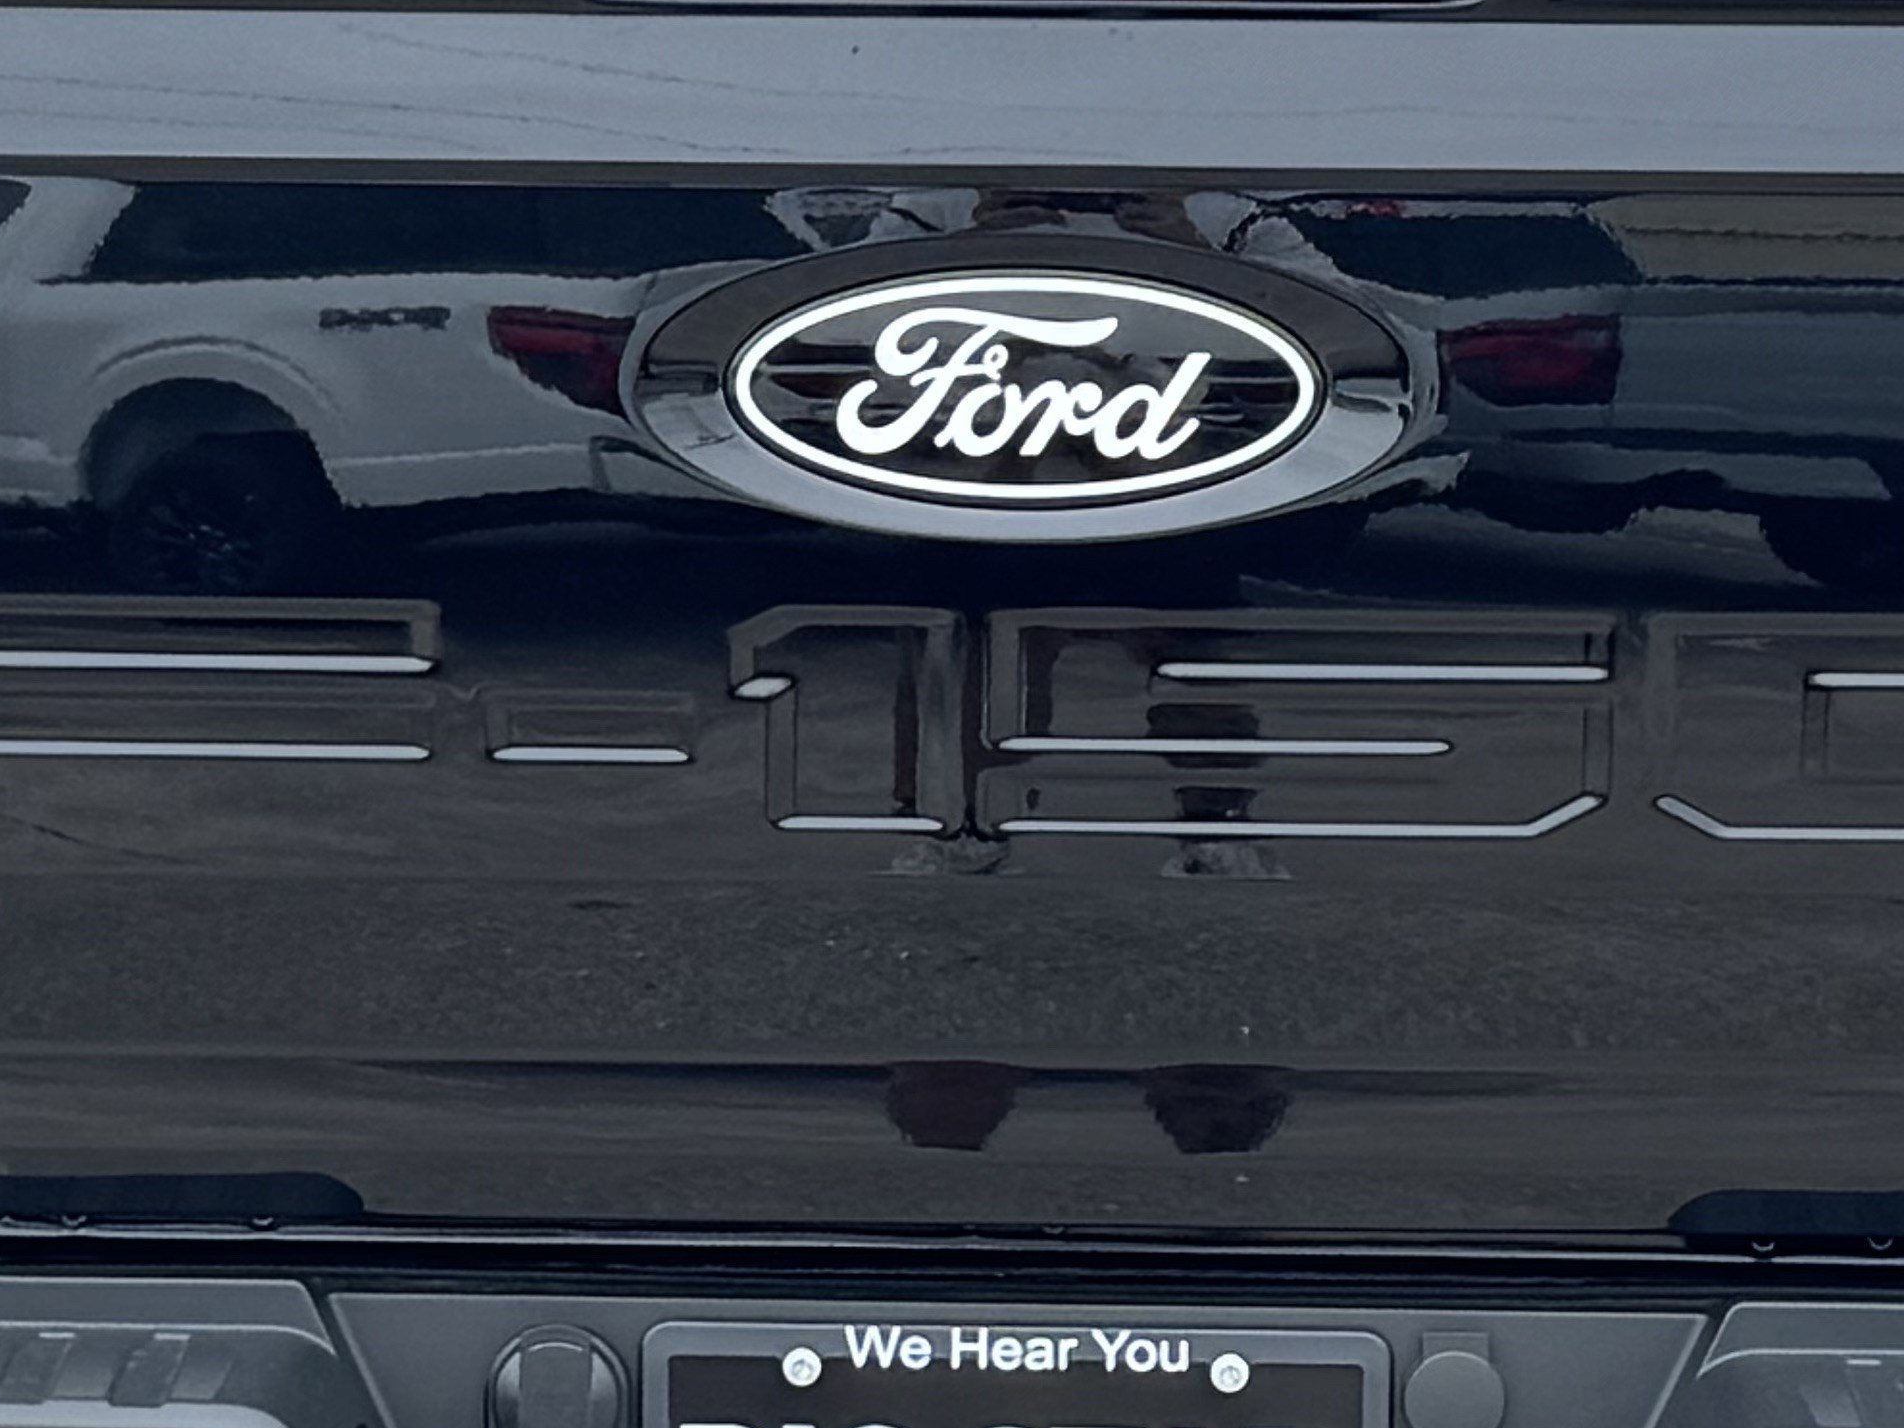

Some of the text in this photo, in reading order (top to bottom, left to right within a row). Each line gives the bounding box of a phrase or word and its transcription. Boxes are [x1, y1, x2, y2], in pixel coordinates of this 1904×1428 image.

[836, 307, 1211, 460] Ford
[843, 1324, 1190, 1373] We Hear You
